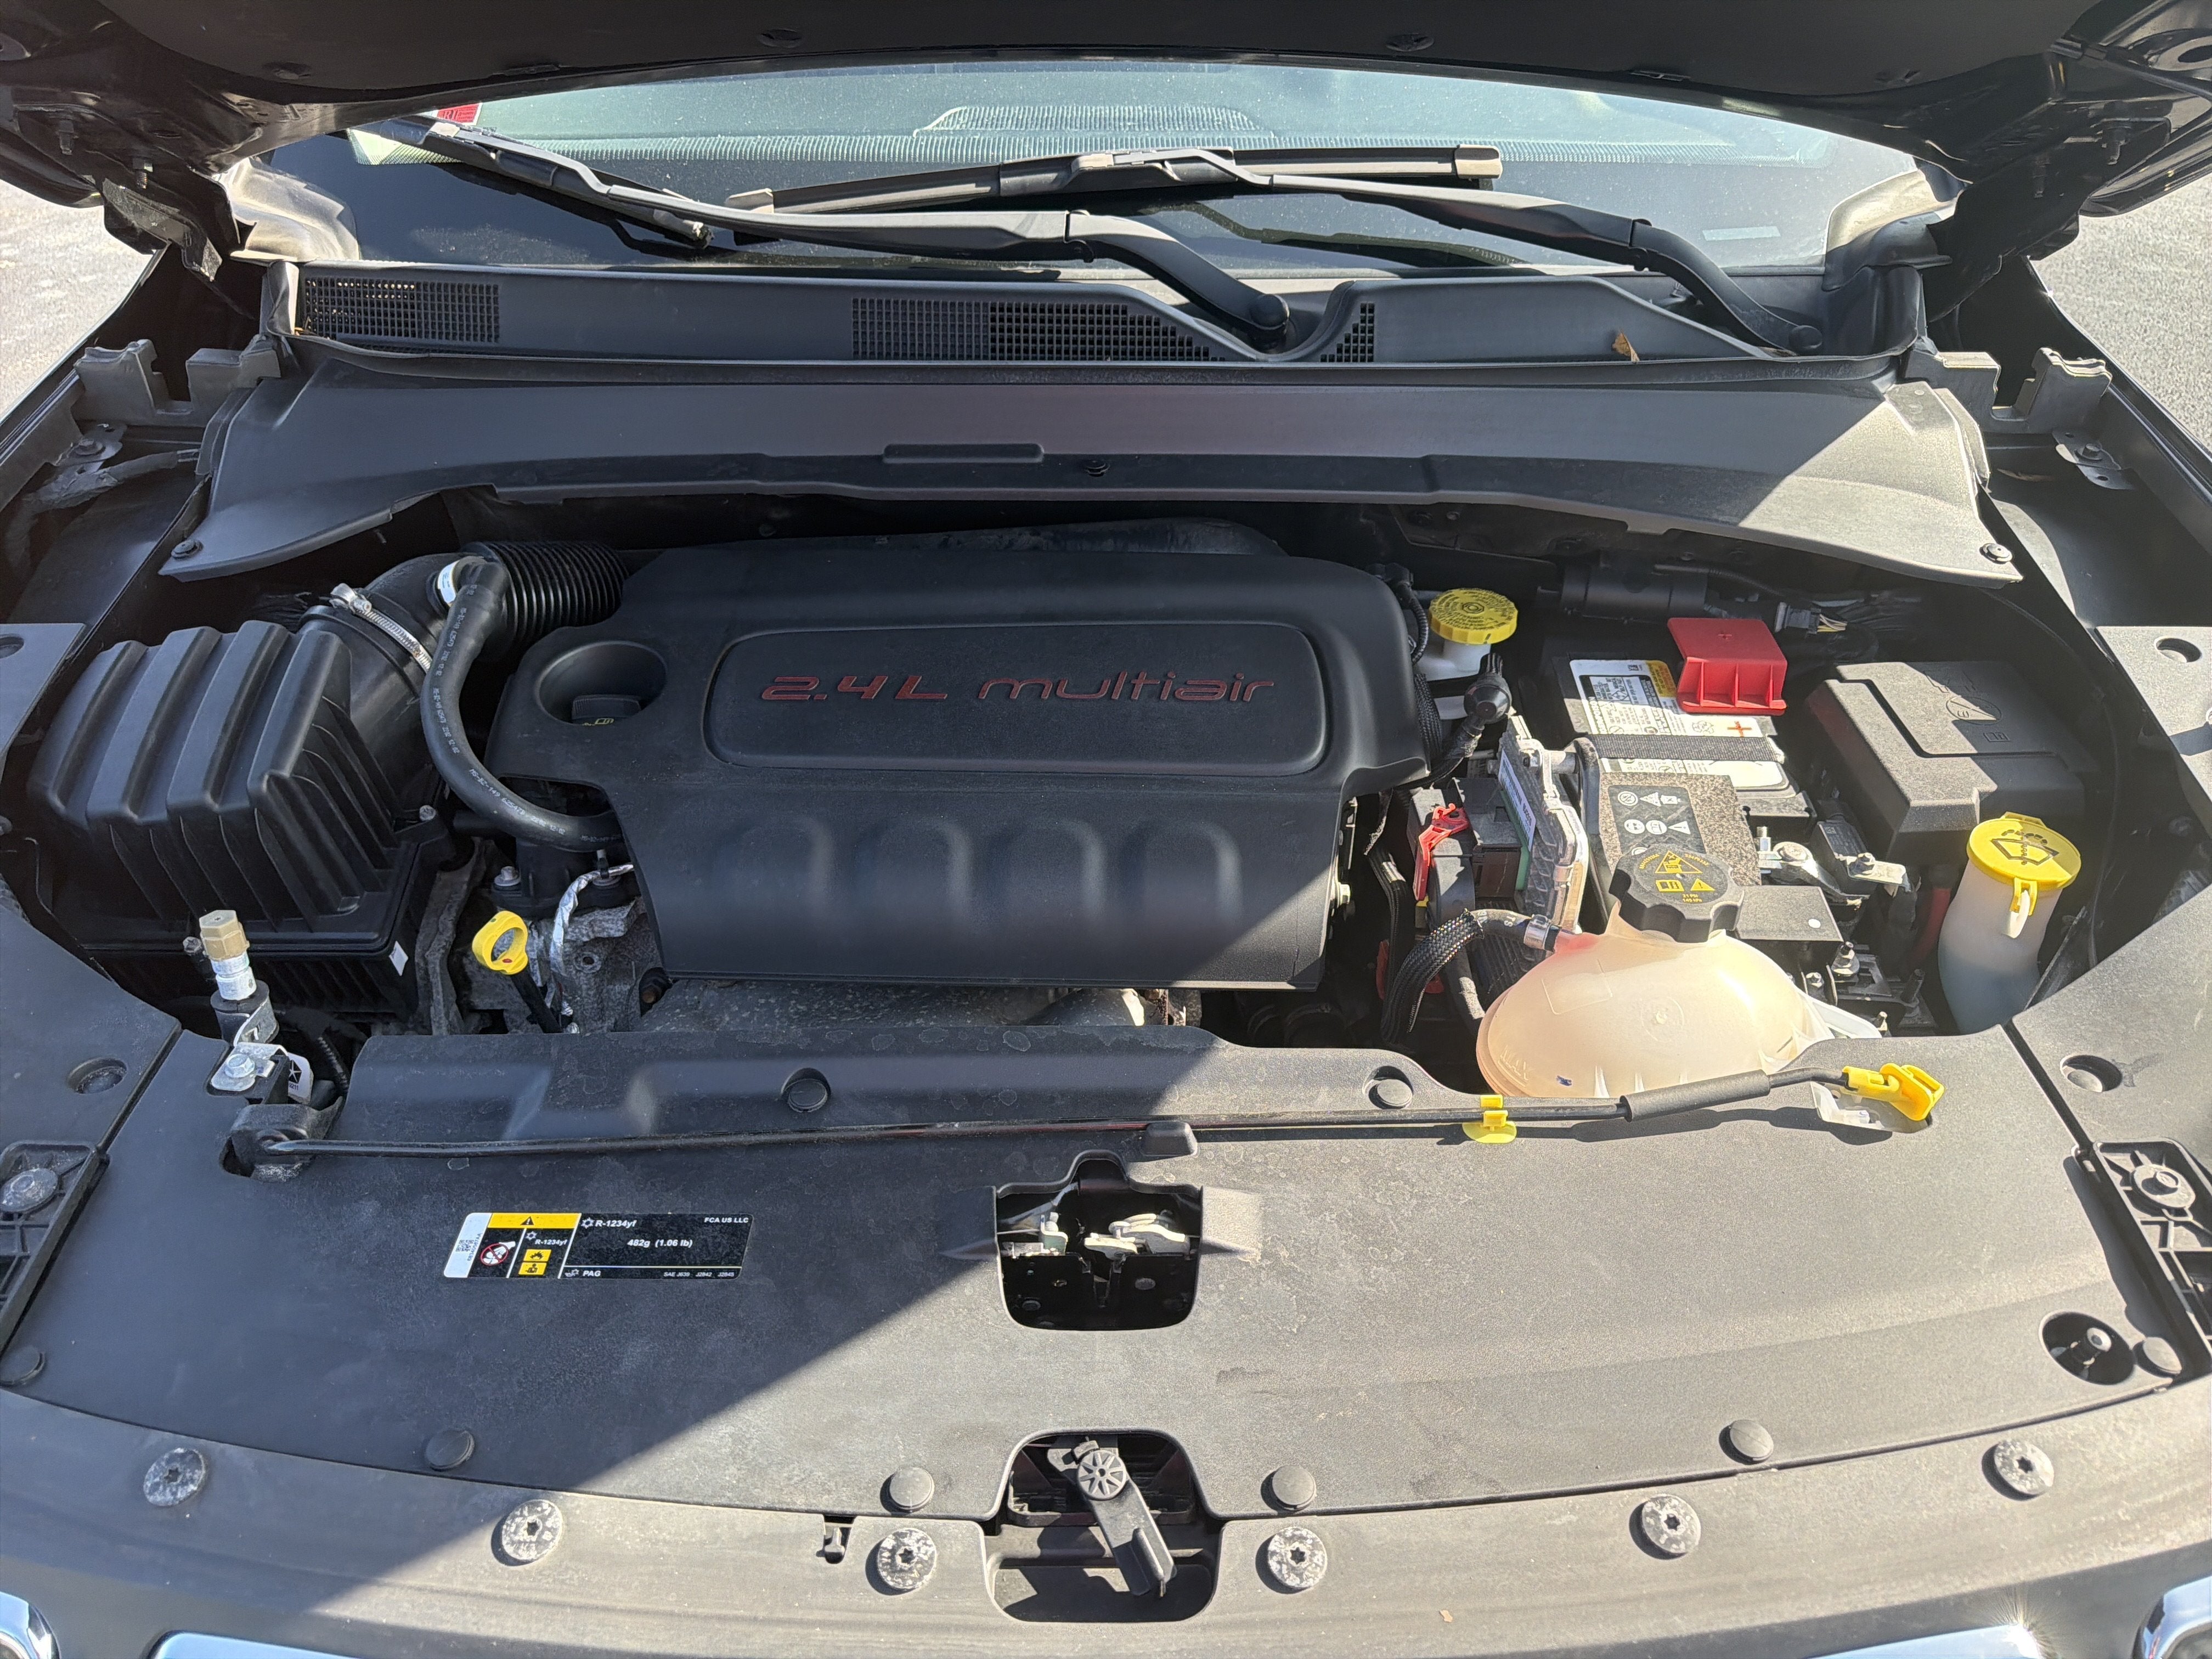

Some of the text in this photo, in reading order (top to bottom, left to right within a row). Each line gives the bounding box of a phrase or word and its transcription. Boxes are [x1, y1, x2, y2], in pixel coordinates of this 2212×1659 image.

[978, 670, 1274, 702] multiair
[595, 1220, 637, 1228] R-1234yf
[627, 1239, 693, 1248] 482g (1.06 lb)
